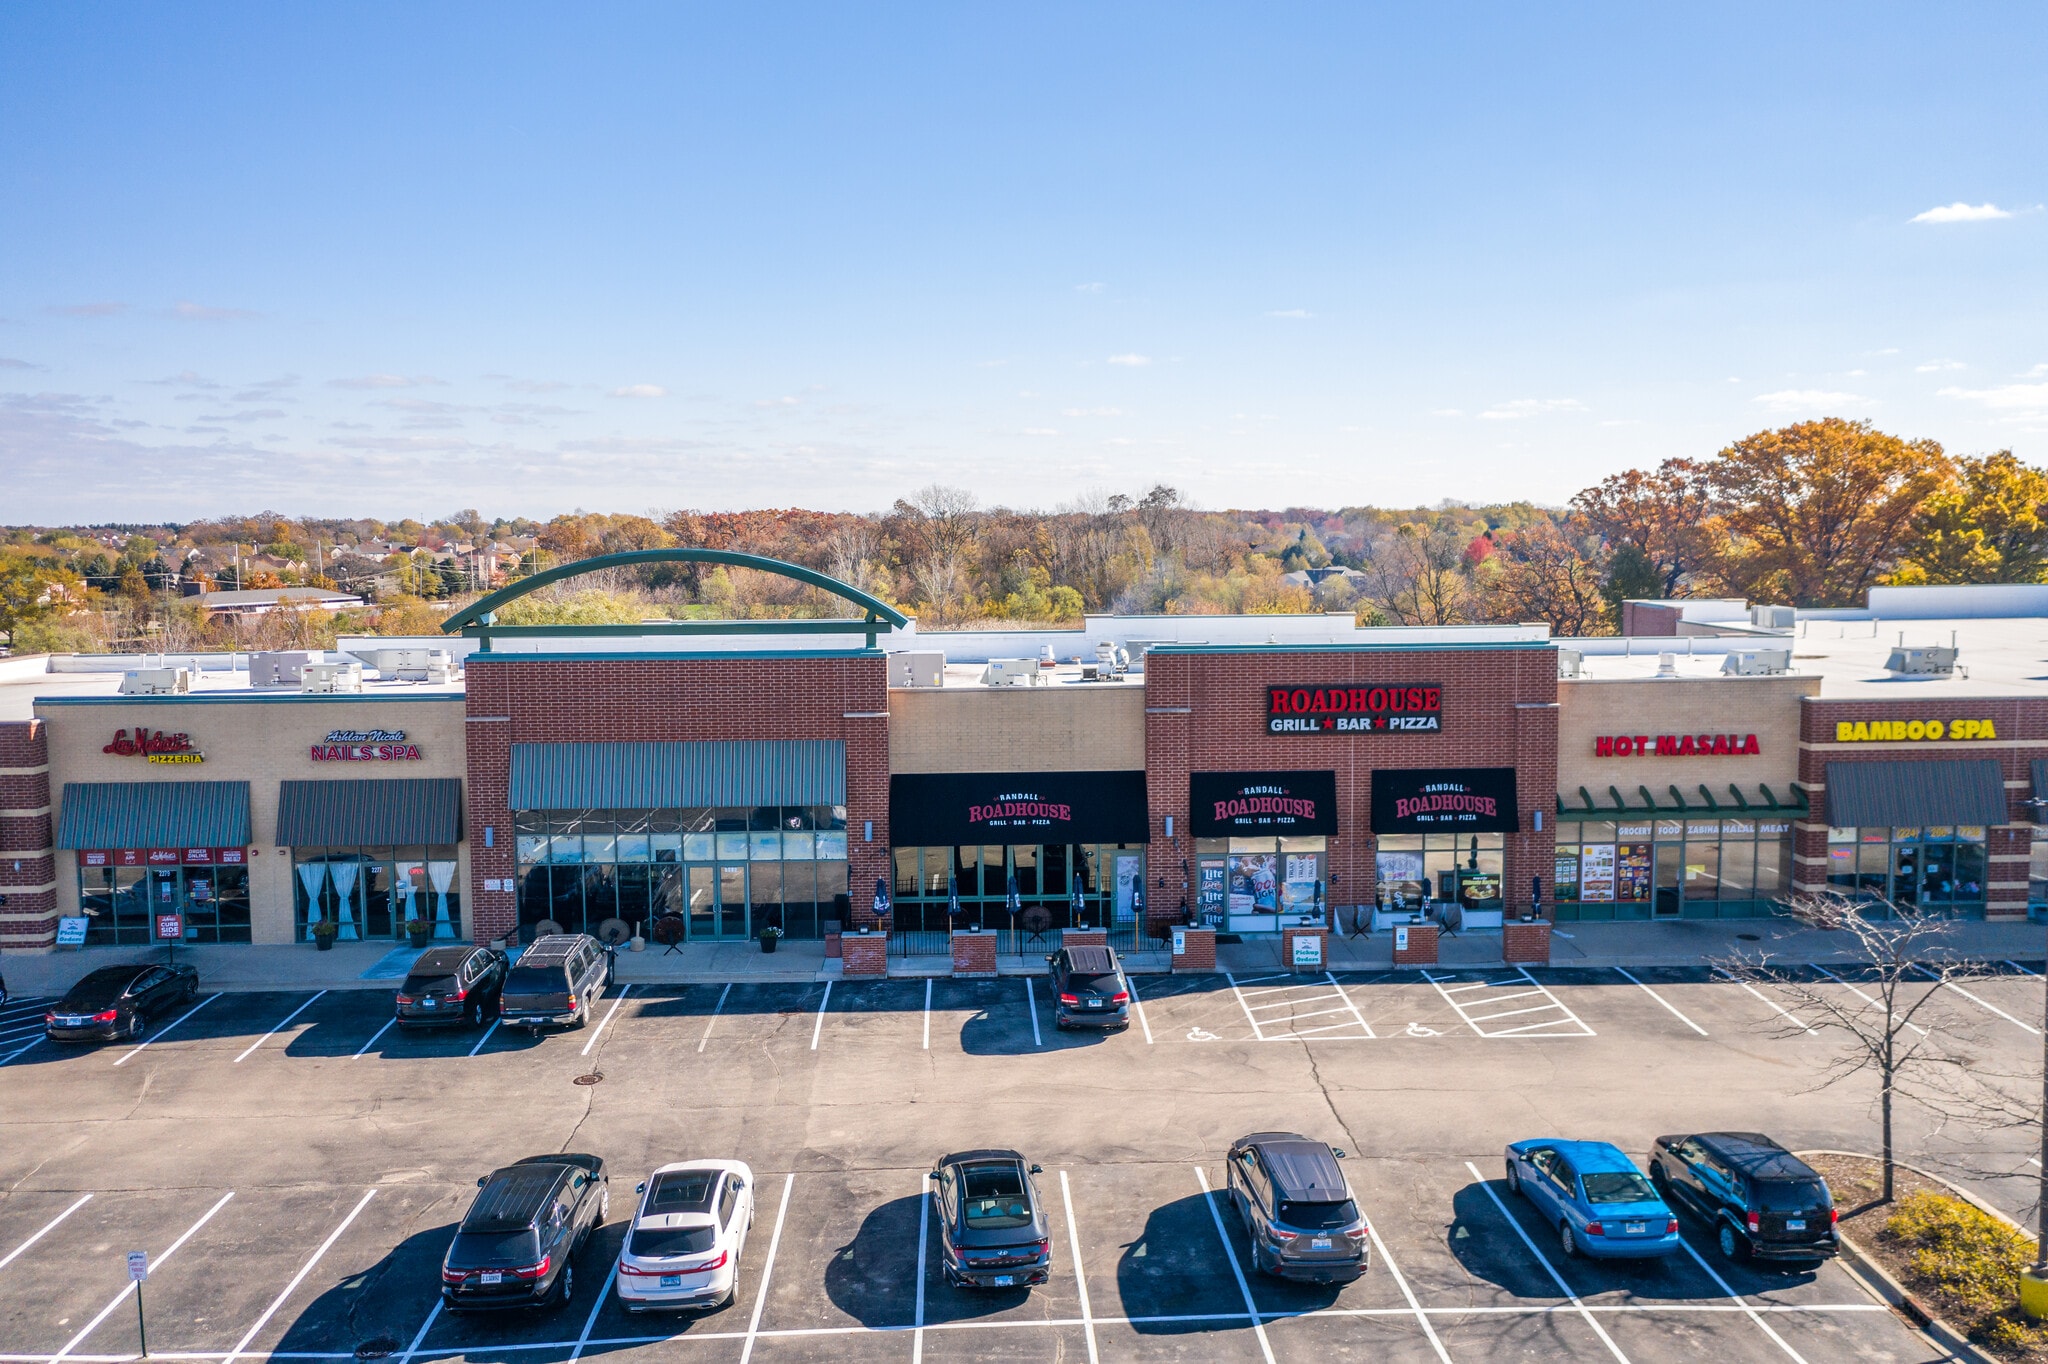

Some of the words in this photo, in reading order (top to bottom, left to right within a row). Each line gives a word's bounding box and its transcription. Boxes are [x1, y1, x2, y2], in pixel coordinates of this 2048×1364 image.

[1270, 688, 1441, 714] ROADHOUSE
[1270, 718, 1320, 731] GRILL
[1336, 717, 1371, 730] BAR
[1389, 716, 1438, 730] PIZZA
[369, 729, 406, 742] Nicole
[1837, 720, 1944, 742] BAMBOO
[1948, 719, 1997, 741] SPA
[1596, 735, 1650, 758] HOT
[1654, 734, 1761, 757] MASALA
[310, 745, 374, 761] NAILS
[379, 745, 422, 761] SPA
[148, 755, 202, 764] PIZZERIA
[1244, 786, 1283, 795] RANDALL
[1425, 783, 1464, 792] RANDALL
[999, 793, 1039, 801] RANDALL
[969, 802, 1071, 822] ROADHOUSE
[1213, 797, 1316, 821] ROADHOUSE
[1395, 794, 1497, 818] ROADHOUSE
[1618, 826, 1651, 836] GROCERY
[1658, 826, 1680, 835] FOOD
[1722, 824, 1755, 833] HALAL
[1760, 824, 1790, 833] MEAT
[409, 867, 424, 875] OPEN
[1205, 869, 1223, 880] Lite
[1205, 892, 1223, 903] Lite
[1205, 915, 1223, 925] Lite
